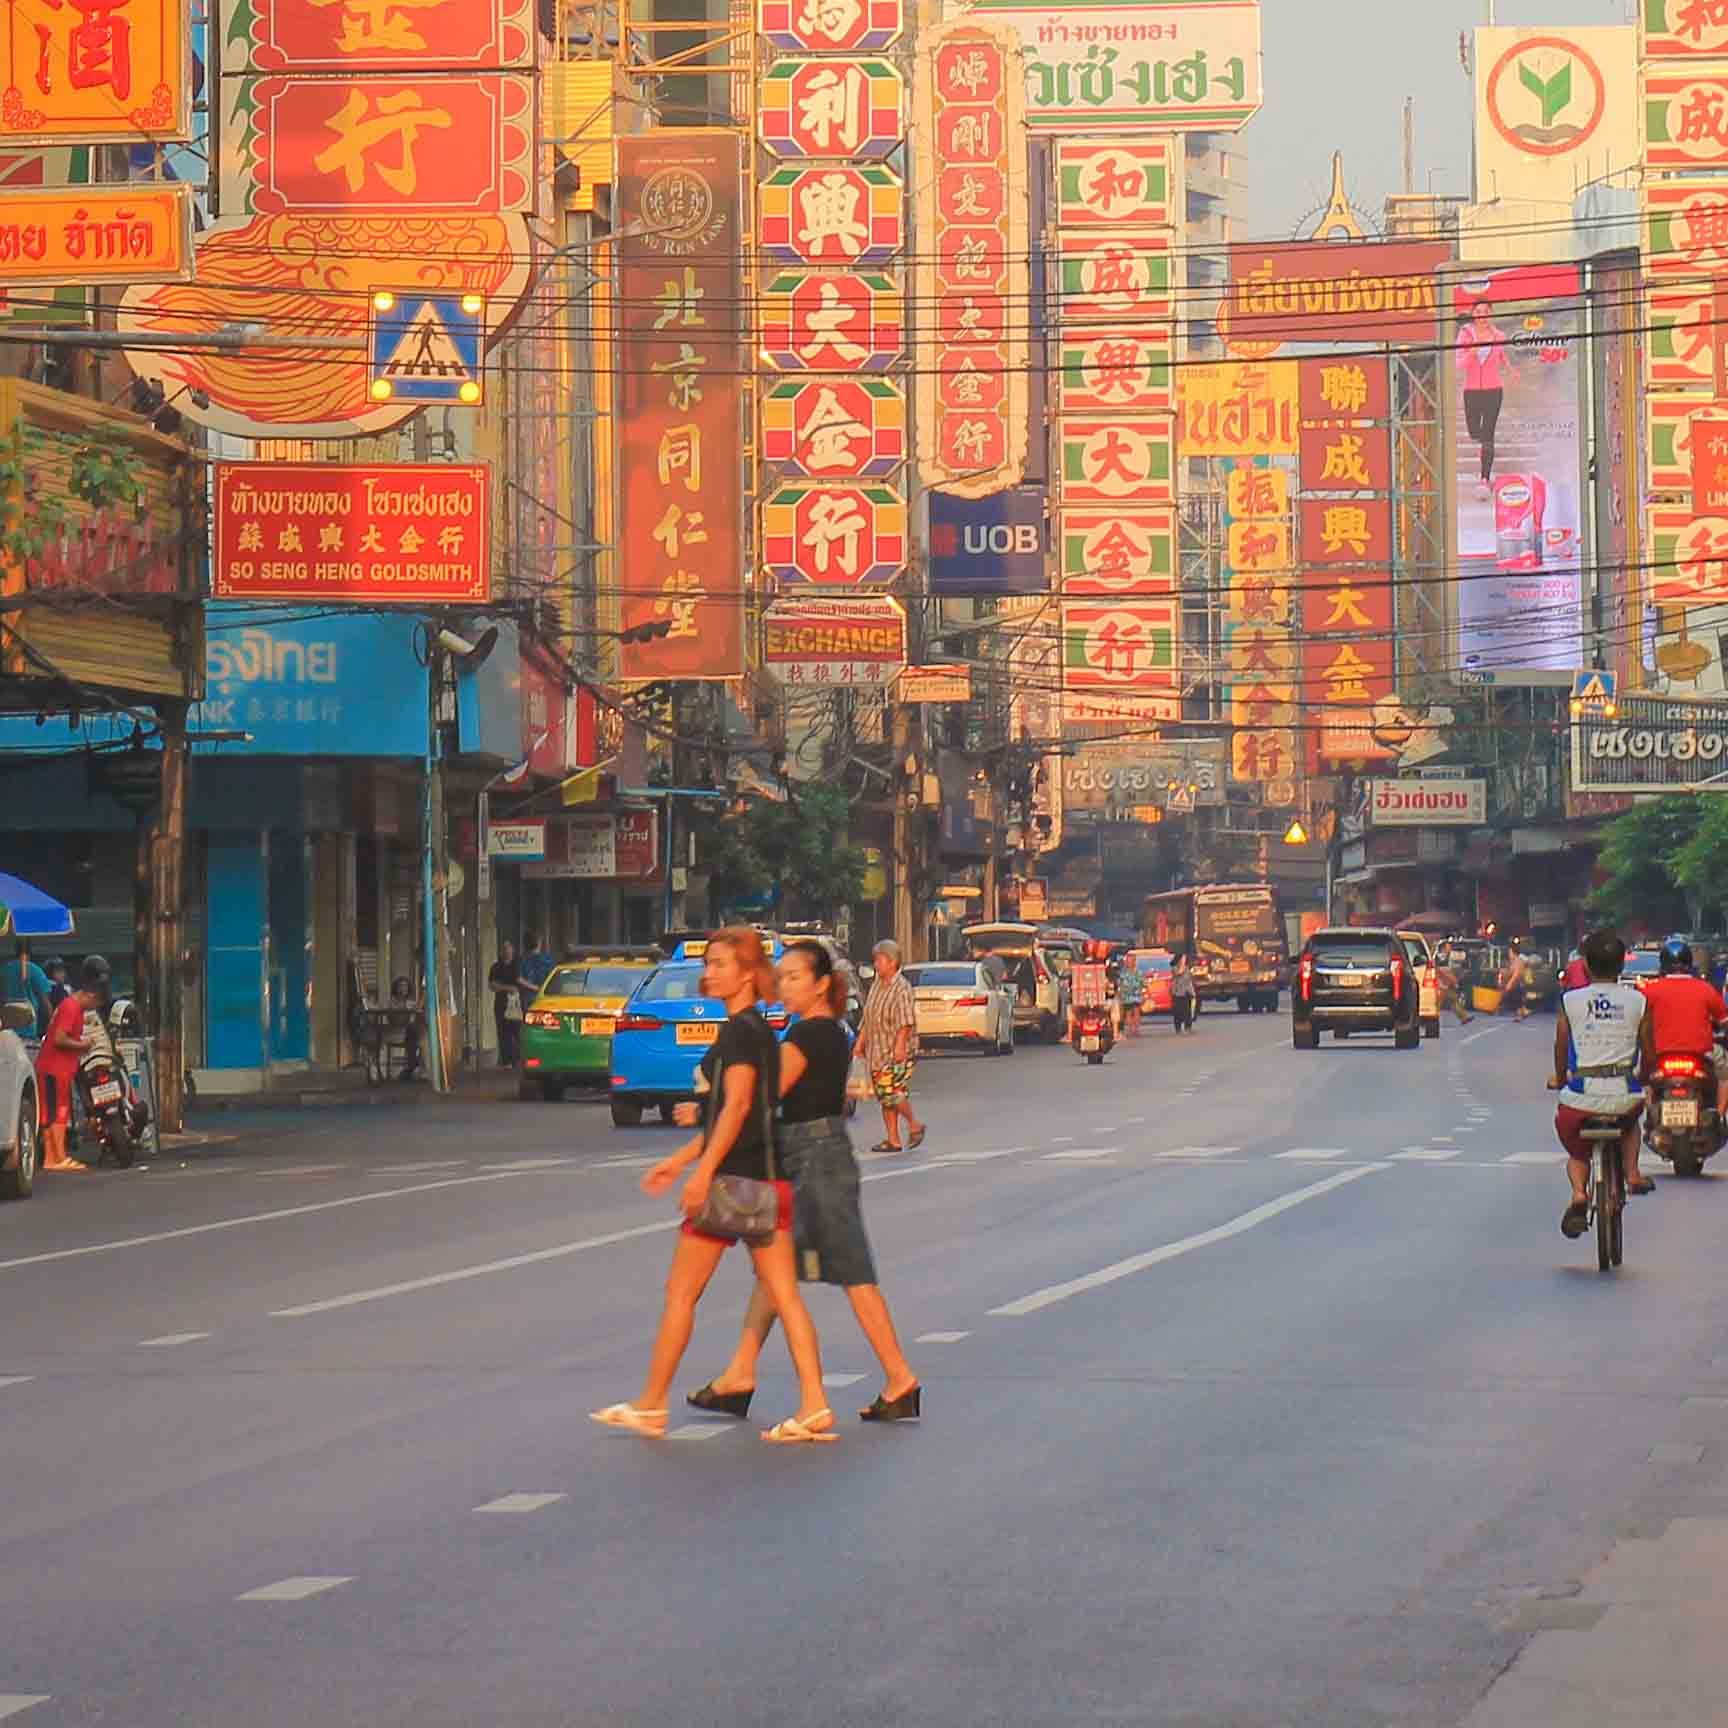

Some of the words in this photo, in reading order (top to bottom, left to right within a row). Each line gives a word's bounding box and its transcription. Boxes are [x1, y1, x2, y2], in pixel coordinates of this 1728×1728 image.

[64, 208, 154, 261] จำกัด
[651, 266, 708, 640] 北京同仁堂
[231, 483, 352, 515] ห้างขายทอง
[963, 524, 1039, 554] UOB
[229, 561, 254, 580] SO
[260, 561, 308, 580] SENG
[315, 562, 364, 581] HENG
[370, 562, 473, 583] GOLDSMITH
[766, 626, 900, 654] EXCHANGE
